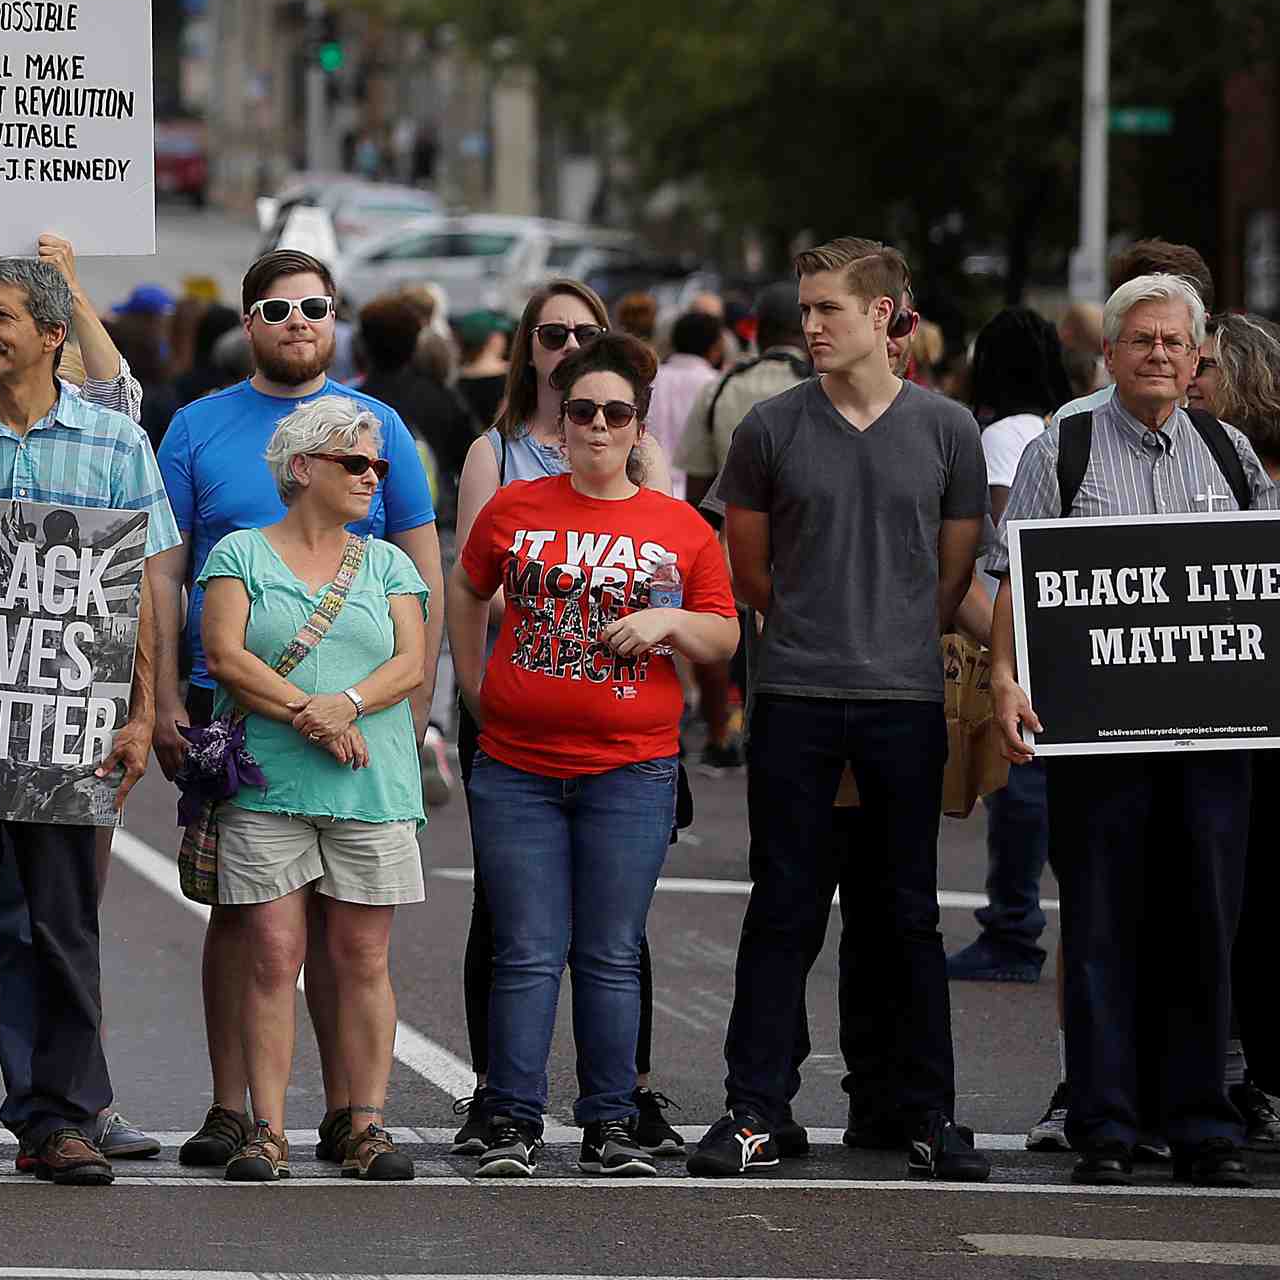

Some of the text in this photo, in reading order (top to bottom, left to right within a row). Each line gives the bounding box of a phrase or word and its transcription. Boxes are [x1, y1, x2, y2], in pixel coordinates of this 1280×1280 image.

[25, 54, 85, 81] MAKE
[15, 86, 134, 119] REVOLUTION
[508, 530, 678, 574] IT WAS
[1035, 563, 1280, 608] BLACK LIVE
[1089, 624, 1265, 666] MATTER
